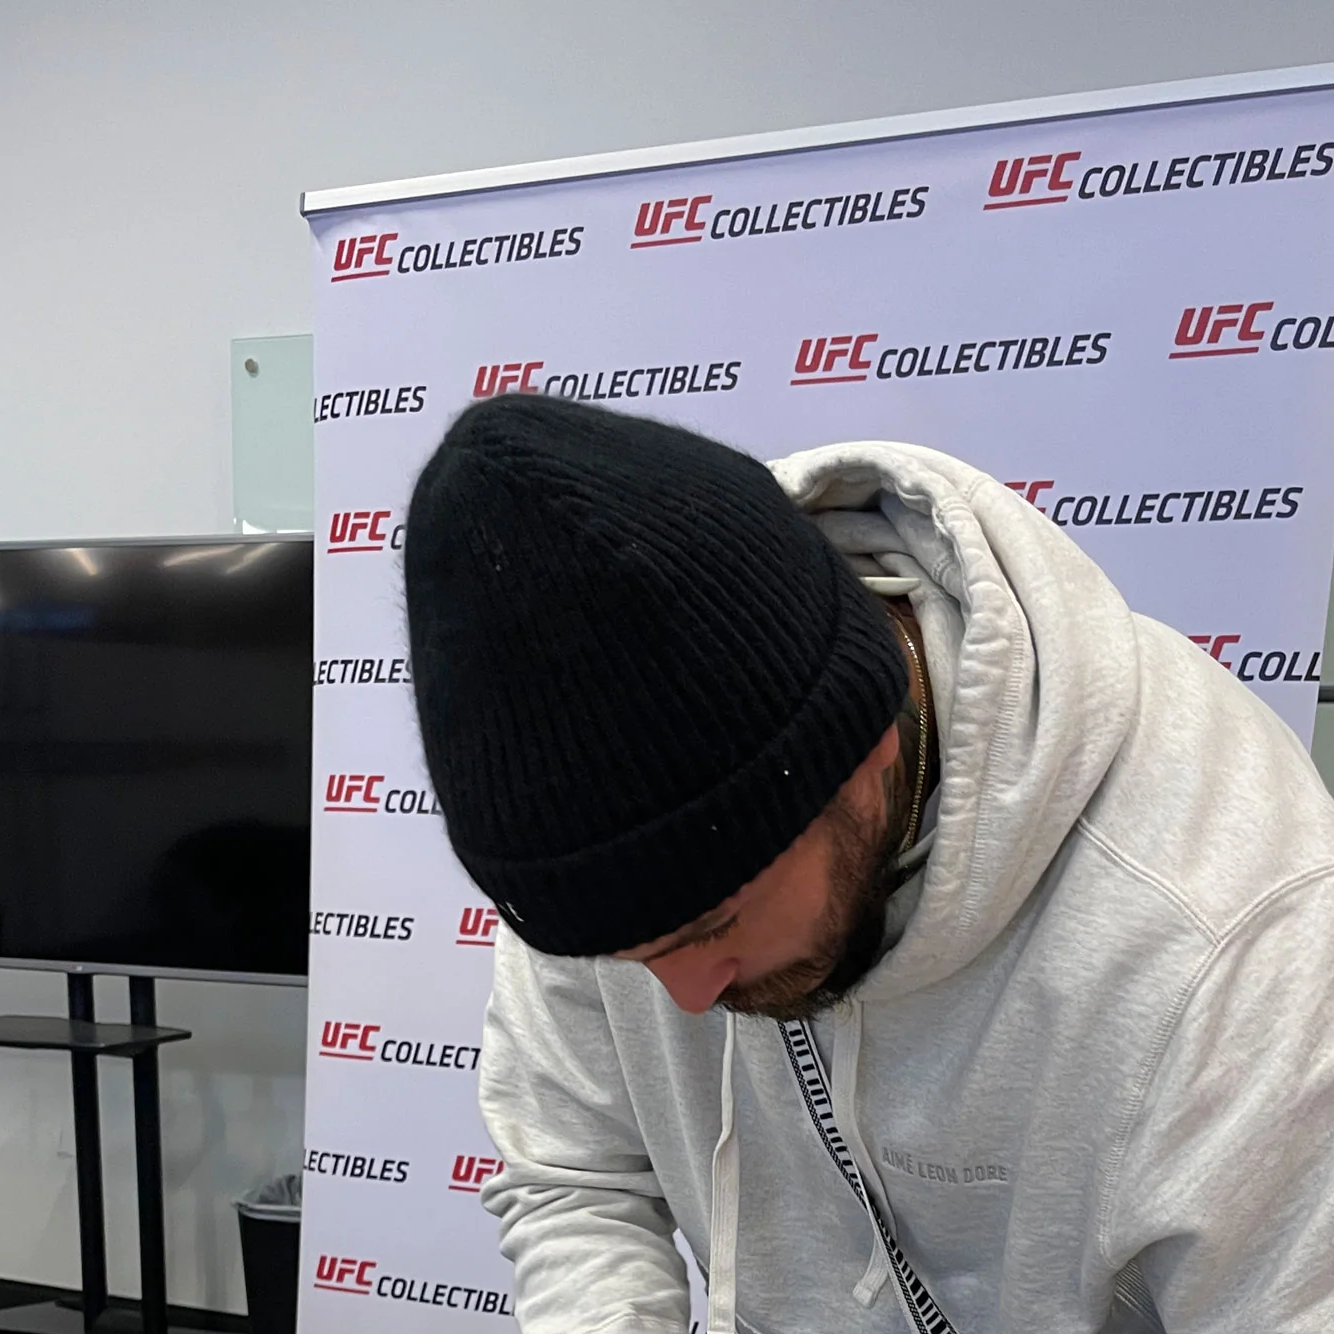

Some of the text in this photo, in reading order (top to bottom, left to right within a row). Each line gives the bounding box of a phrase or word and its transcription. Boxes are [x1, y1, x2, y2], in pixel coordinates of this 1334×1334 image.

[986, 152, 1081, 196] UFC
[633, 187, 930, 239] UFC COLLECTIBLES
[334, 227, 584, 273] UFC COLLECTIBLES
[1174, 302, 1274, 345] UFC
[795, 333, 1112, 380] UFC COLLECTIBLES
[473, 361, 742, 401] UFC COLLECTIBLES
[329, 511, 391, 543] UFC
[1051, 487, 1305, 527] COLLECTIBLES
[325, 775, 385, 803] UFC
[459, 907, 498, 936] UF
[321, 1021, 481, 1071] UFC COLLECT
[918, 1161, 958, 1184] LEON
[963, 1165, 1008, 1183] DORE
[316, 1255, 515, 1317] UFC COLLECTIBL
